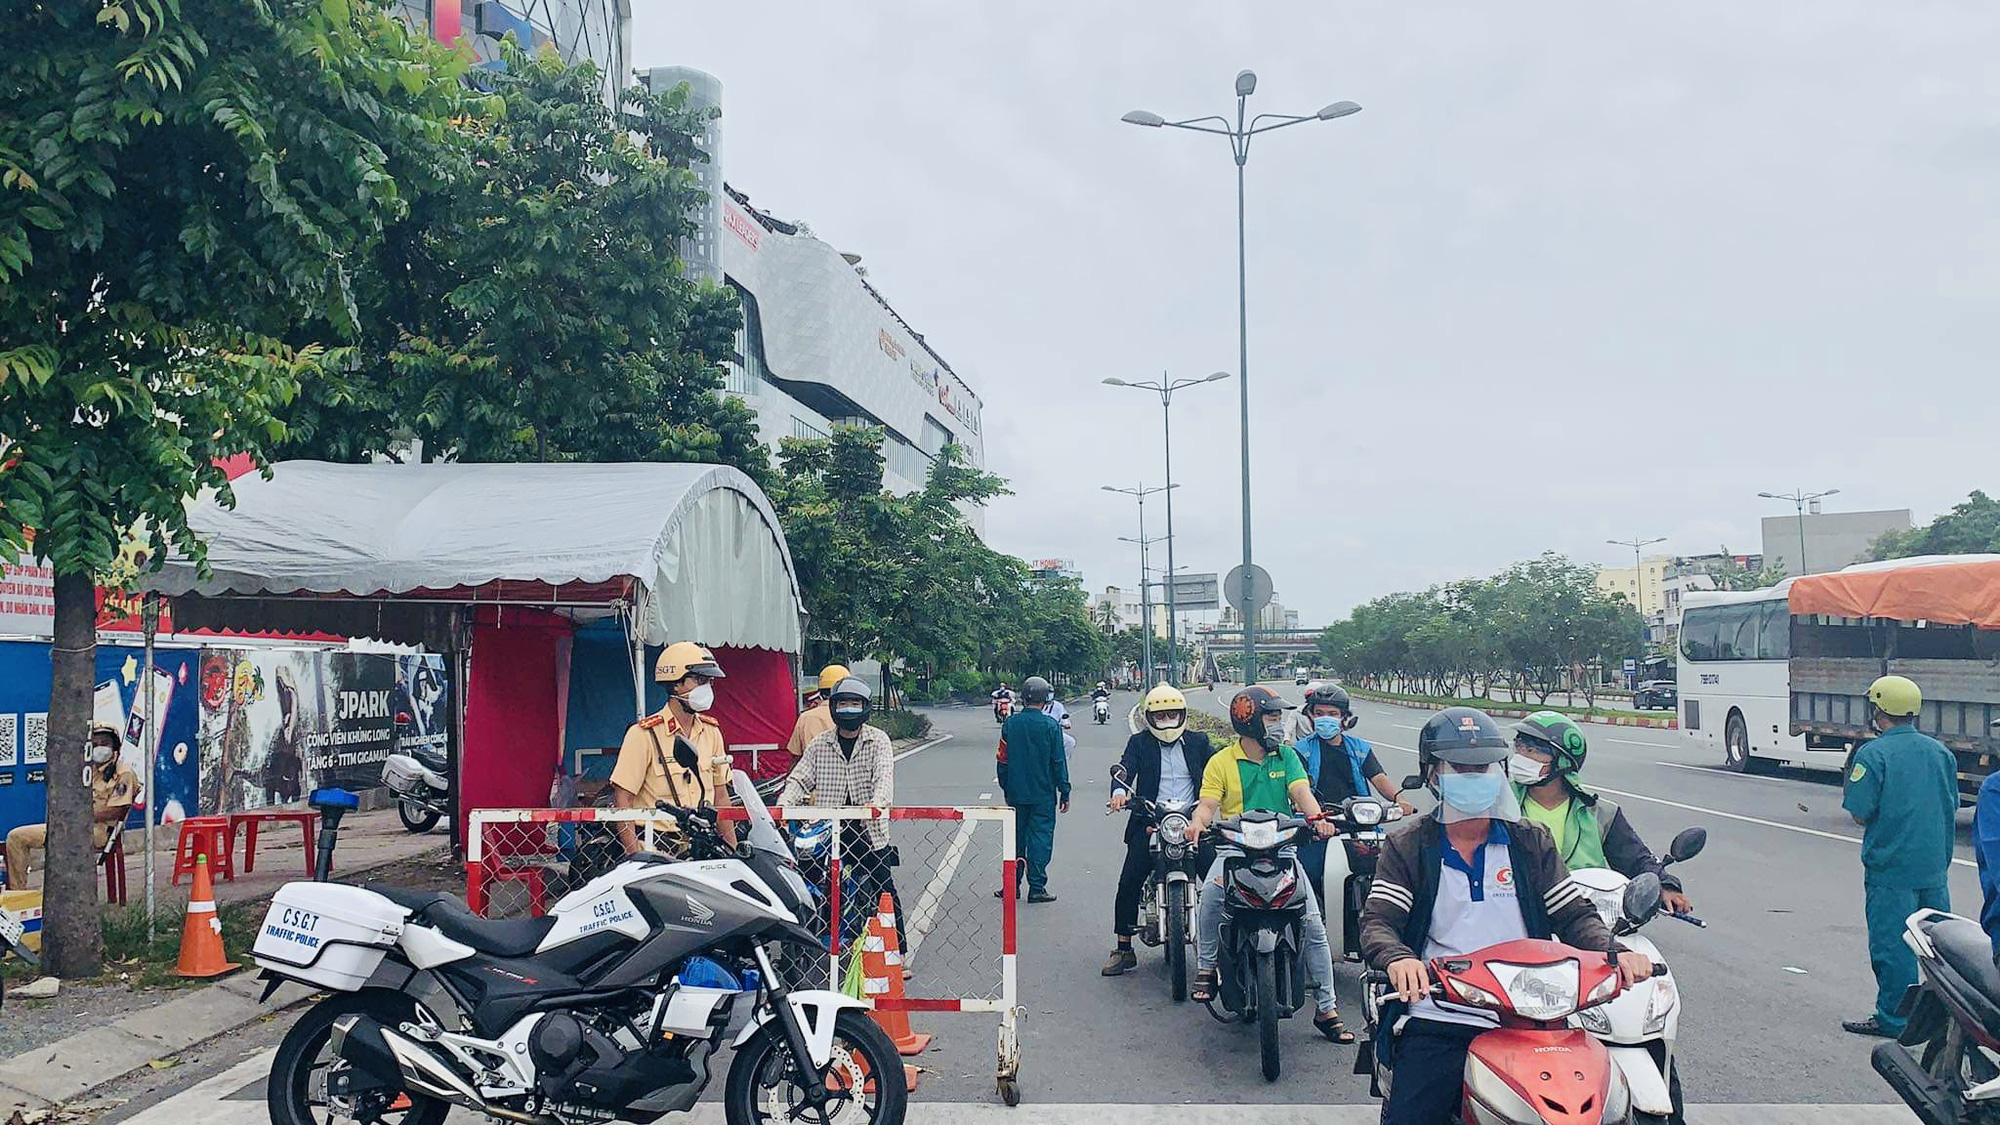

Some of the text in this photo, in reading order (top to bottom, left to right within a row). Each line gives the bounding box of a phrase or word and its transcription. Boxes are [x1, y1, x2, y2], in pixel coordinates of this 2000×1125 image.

[340, 690, 391, 720] JPARK
[307, 726, 391, 748] CÔNG VIÊN KHỦNG LONG
[306, 751, 328, 770] TẦNG
[328, 754, 334, 768] 6
[338, 752, 357, 767] TTTM
[700, 863, 727, 871] POLICE
[579, 911, 634, 934] TRAFFIC POLICE
[680, 915, 713, 926] HONDA
[266, 925, 320, 948] TRAFFIC POLICE
